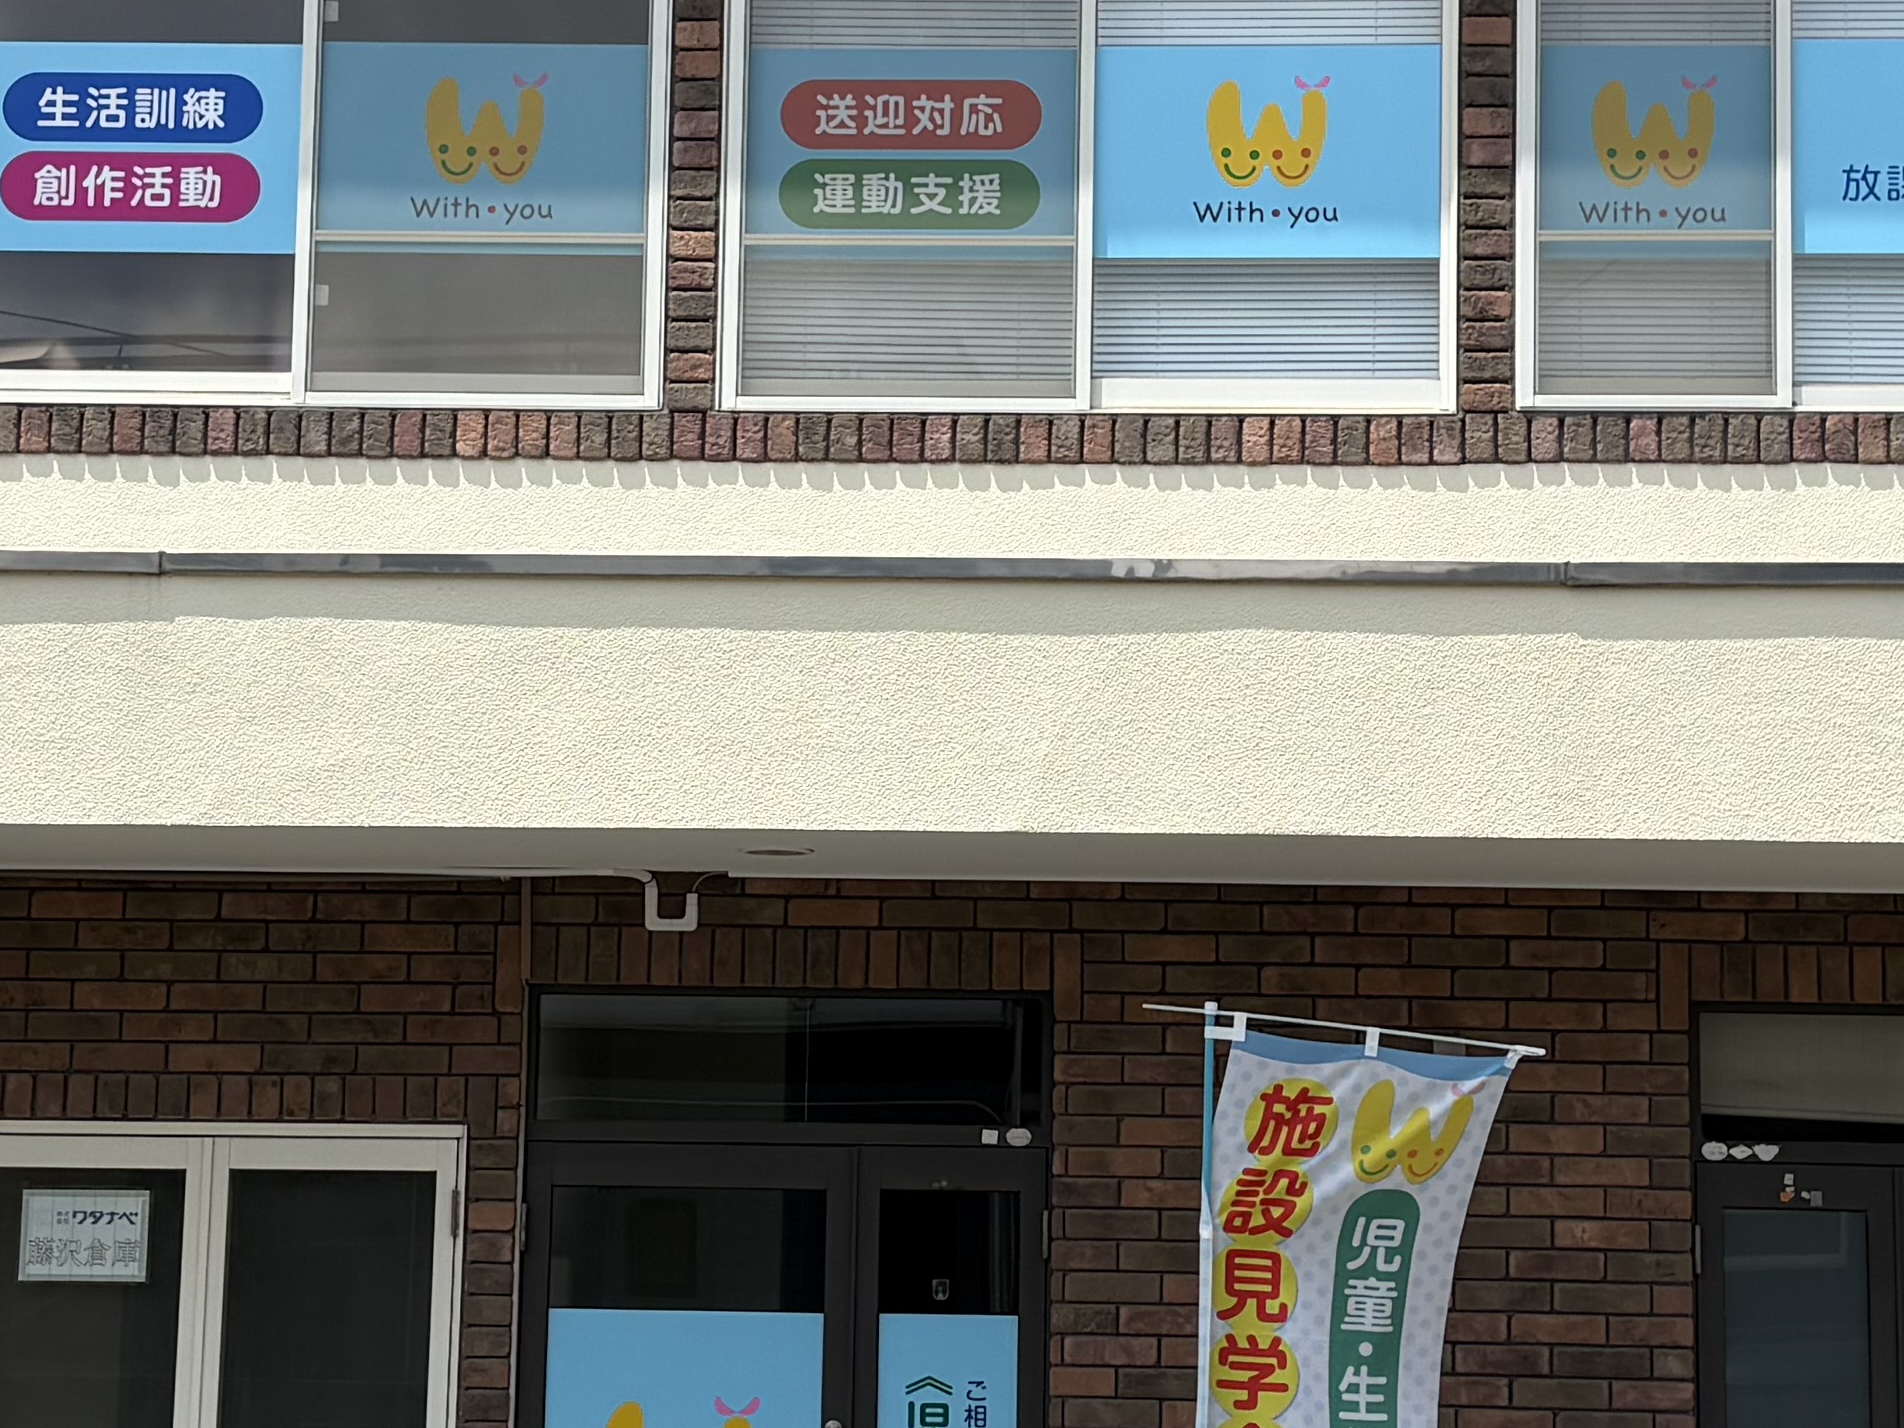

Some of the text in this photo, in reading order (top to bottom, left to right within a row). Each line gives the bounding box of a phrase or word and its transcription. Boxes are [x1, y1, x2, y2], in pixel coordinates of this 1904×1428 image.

[37, 86, 226, 131] 生活訓練
[814, 93, 1004, 138] 送迎対応
[33, 165, 222, 209] 創作活動
[813, 173, 1001, 216] 運動支援
[72, 1211, 138, 1226] ワタナベ
[26, 1237, 141, 1267] 藤沢倉庫
